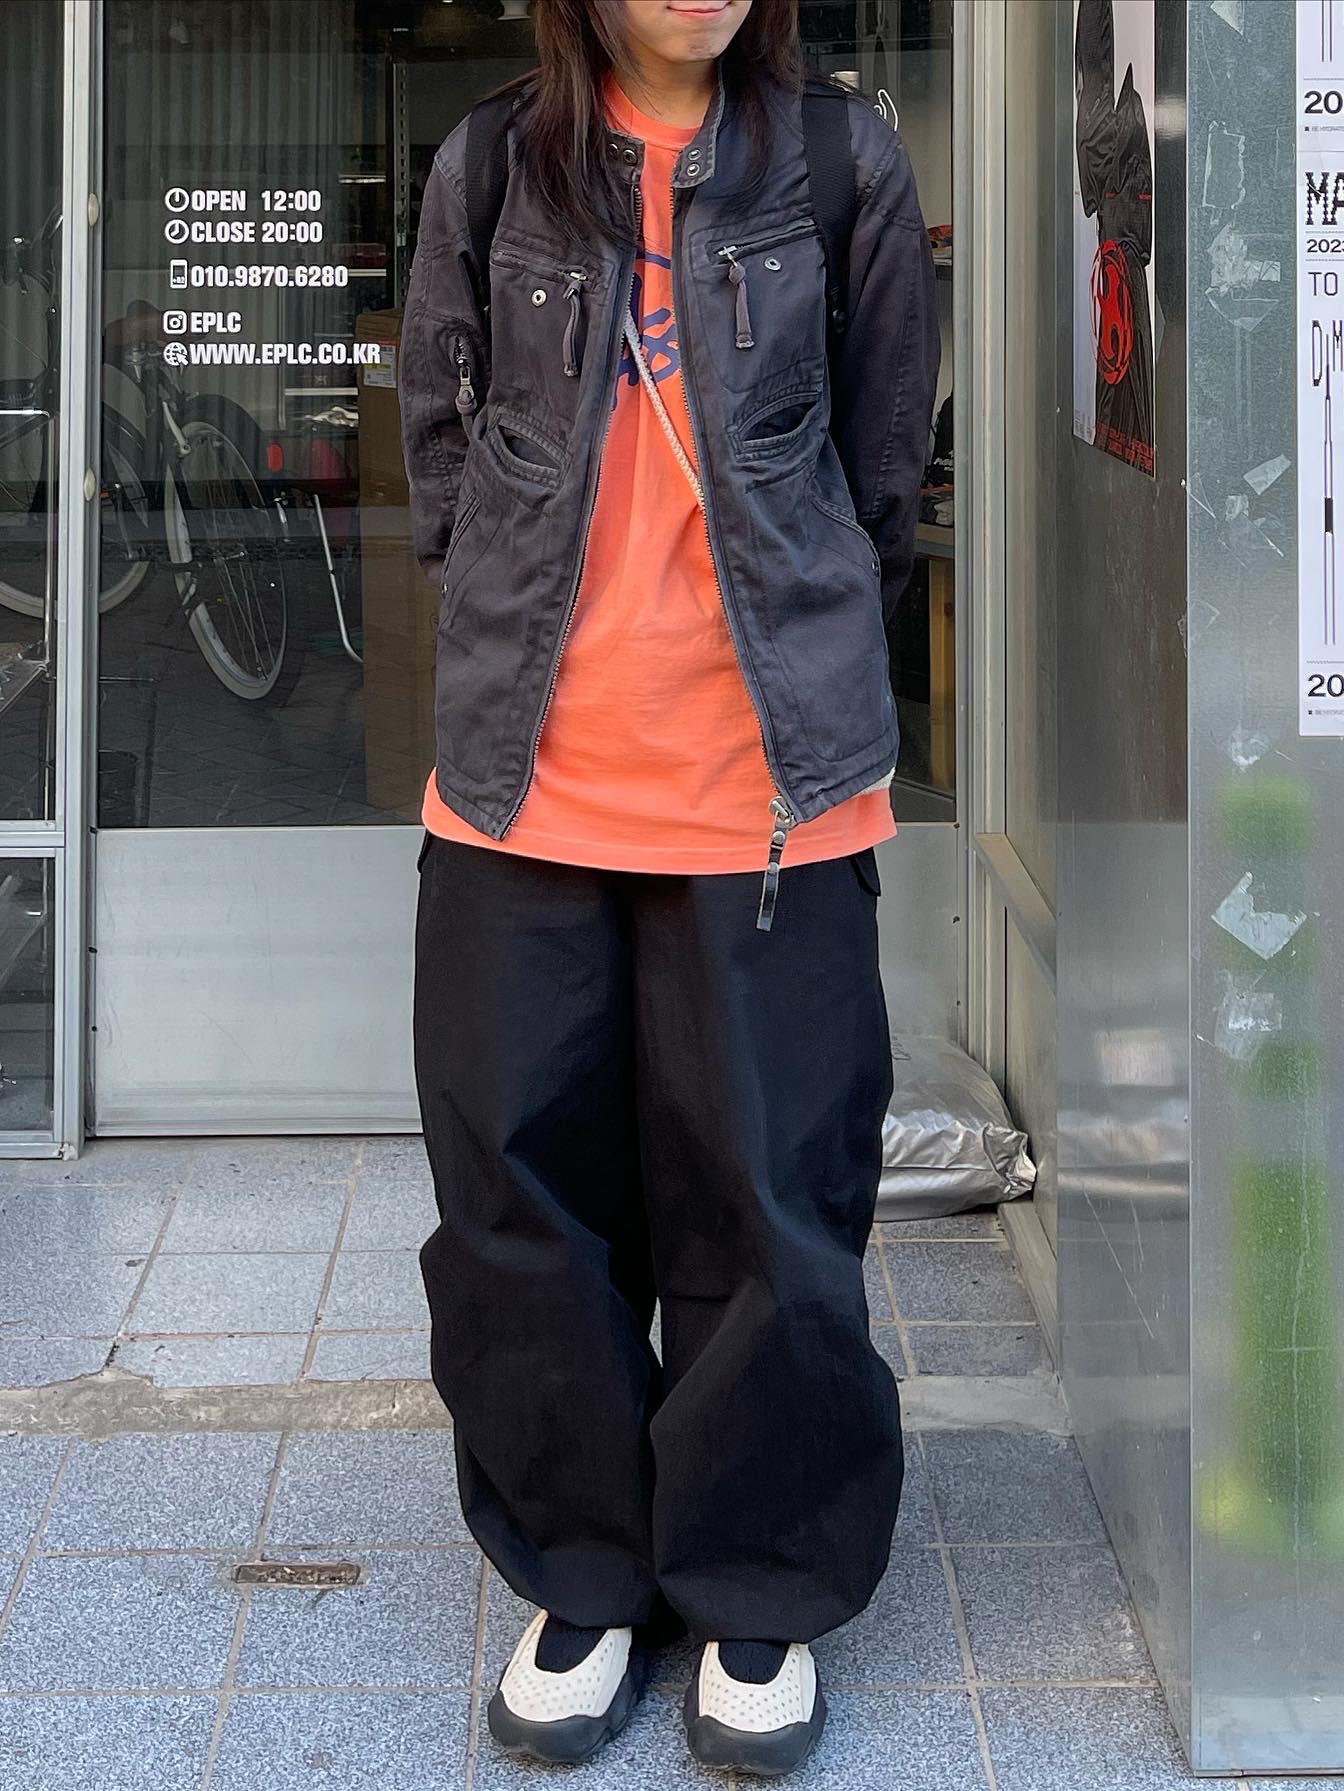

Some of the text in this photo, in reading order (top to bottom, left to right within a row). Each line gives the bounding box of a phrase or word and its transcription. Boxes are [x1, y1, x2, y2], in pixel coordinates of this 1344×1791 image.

[191, 190, 321, 212] OPEN 12:00
[191, 221, 323, 243] CLOSE 20:00
[1307, 239, 1344, 253] 202
[190, 265, 349, 288] 010.9870.6280
[1308, 272, 1338, 297] TO
[190, 311, 242, 334] EPLC
[189, 342, 381, 365] WWW.EPLC.CO.KR
